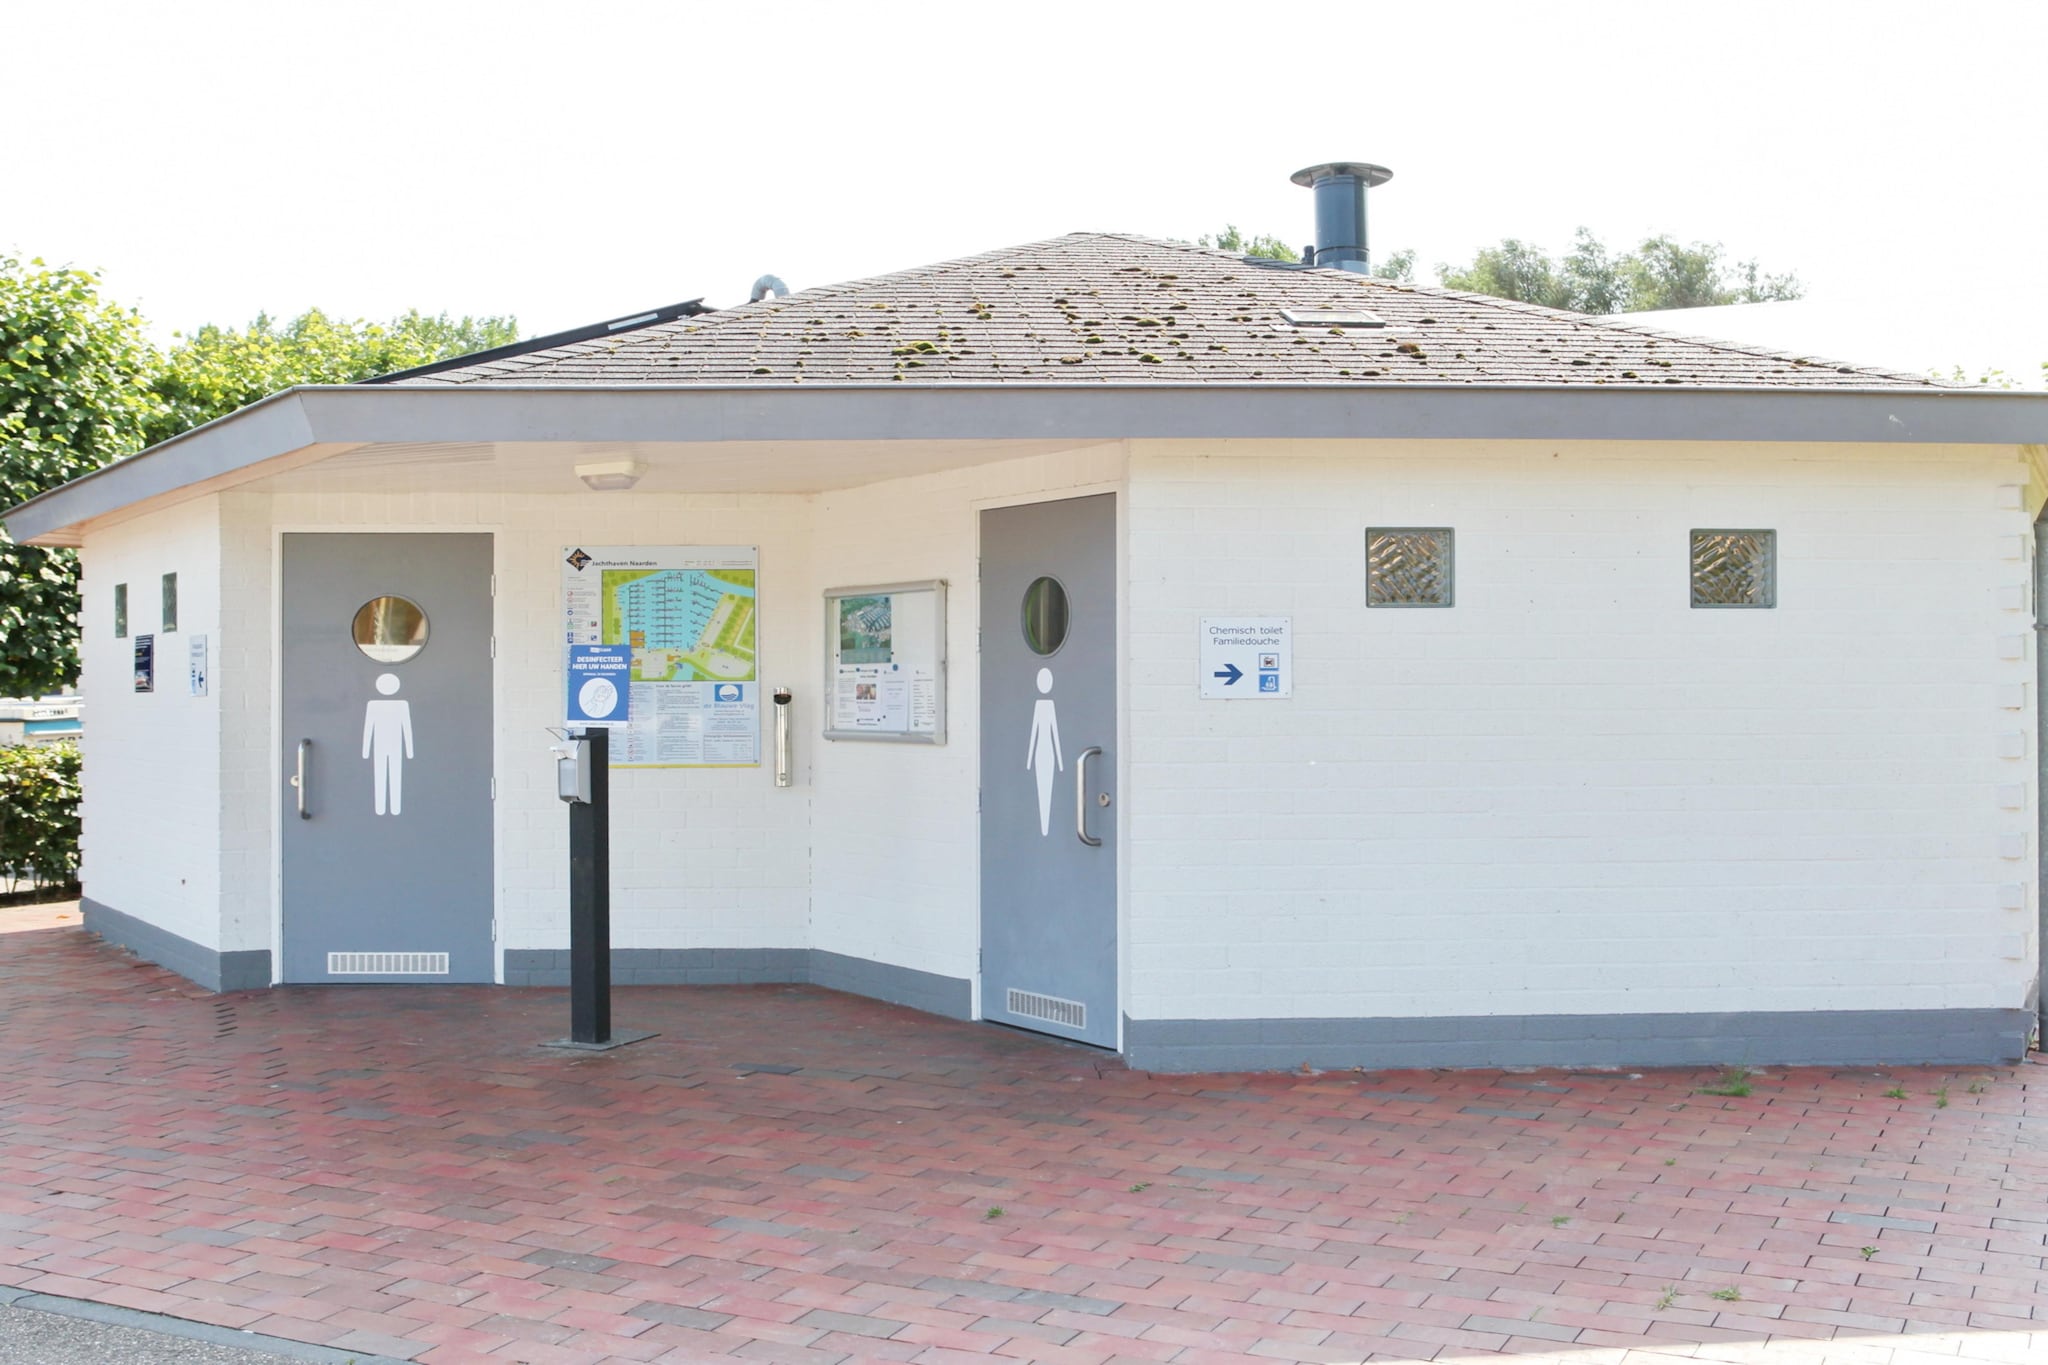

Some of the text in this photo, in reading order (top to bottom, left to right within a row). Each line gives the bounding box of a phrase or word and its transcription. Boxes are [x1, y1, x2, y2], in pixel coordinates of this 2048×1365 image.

[1209, 626, 1283, 635] Chemisch toilet
[1213, 637, 1280, 646] Familiedouche
